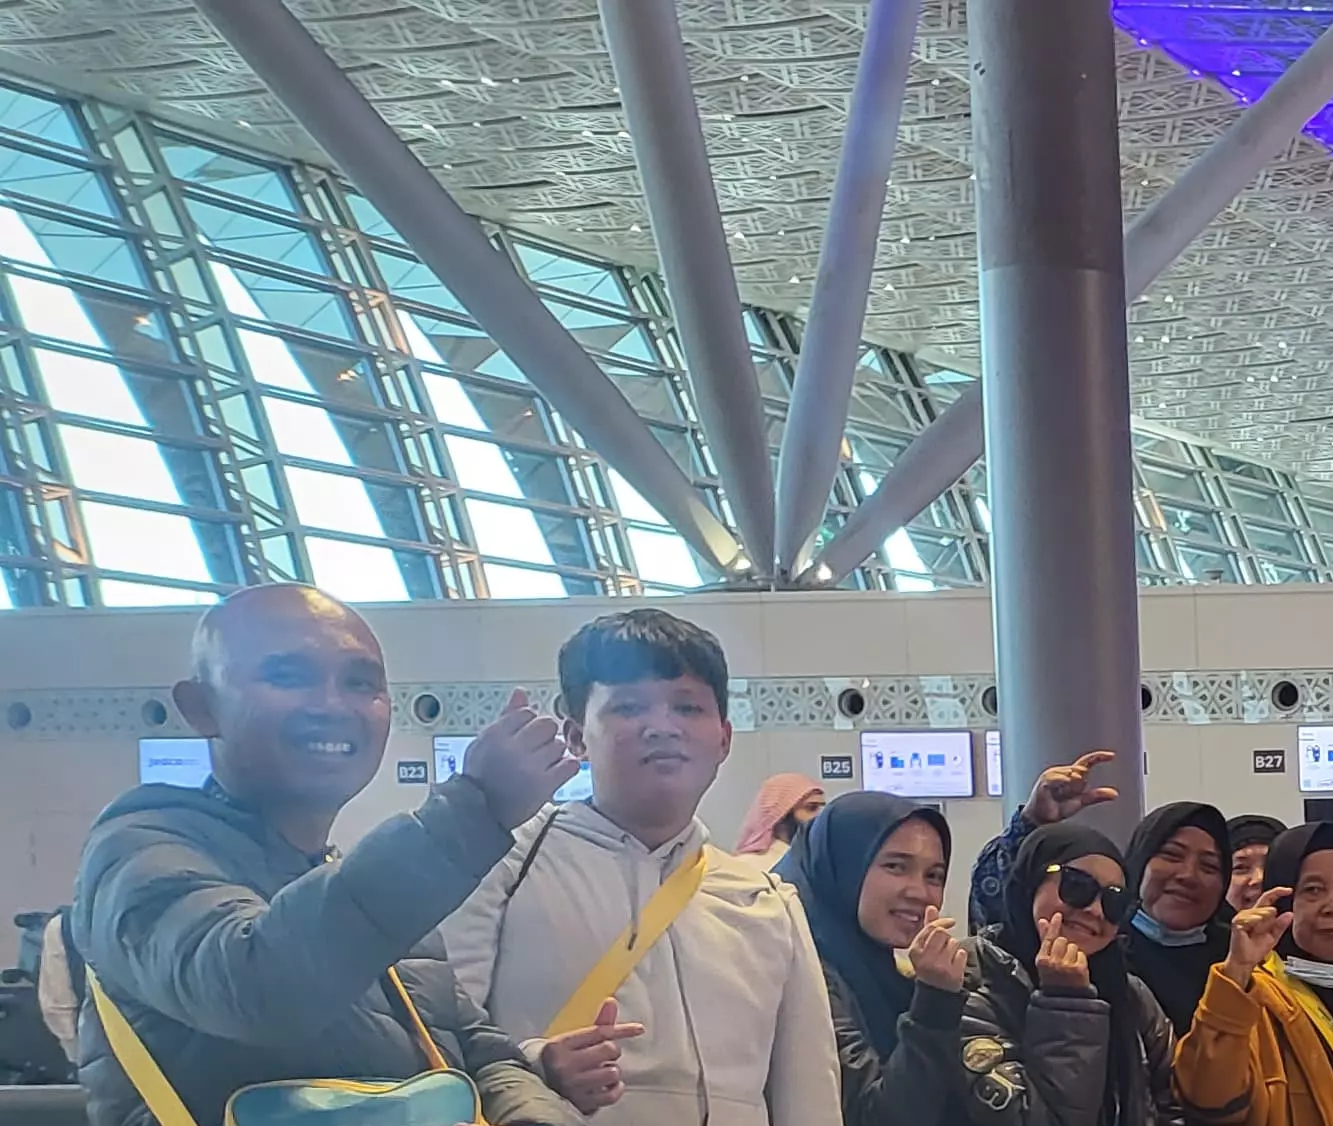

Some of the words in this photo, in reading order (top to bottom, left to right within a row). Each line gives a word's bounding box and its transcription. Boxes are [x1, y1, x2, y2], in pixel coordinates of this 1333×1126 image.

[823, 760, 851, 774] B25
[1255, 755, 1283, 768] B27
[399, 766, 425, 778] B23
